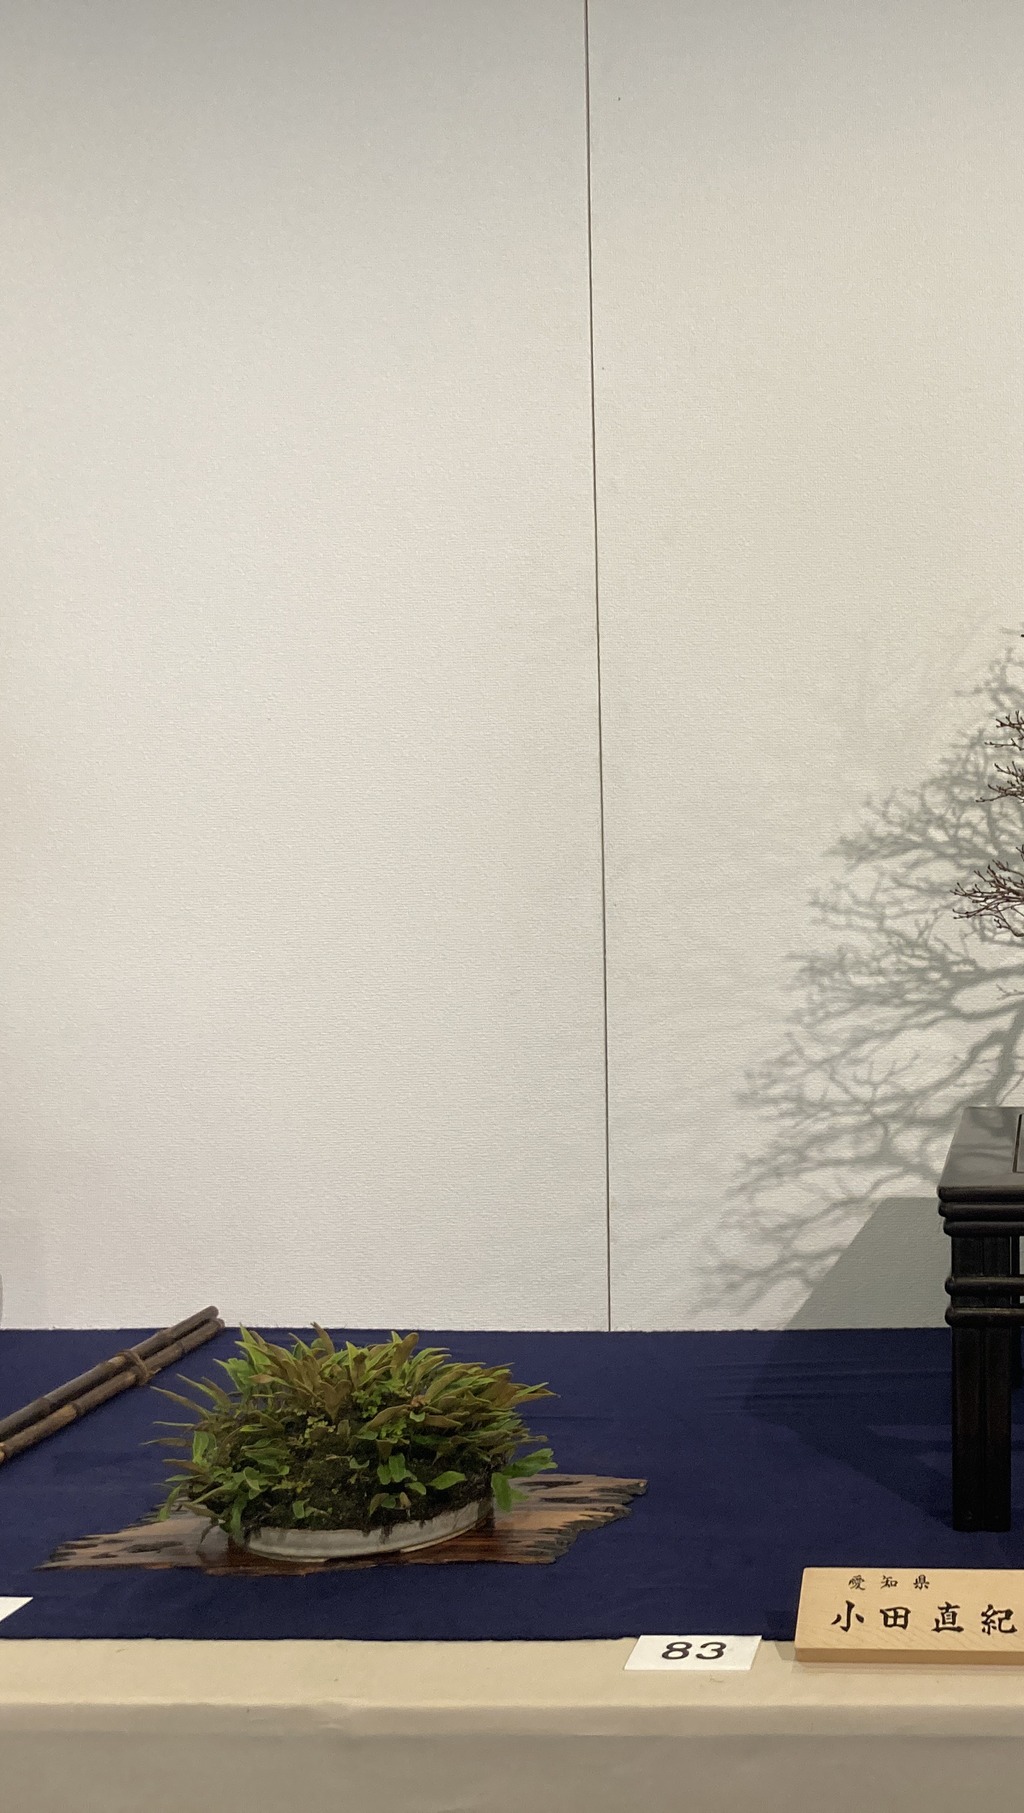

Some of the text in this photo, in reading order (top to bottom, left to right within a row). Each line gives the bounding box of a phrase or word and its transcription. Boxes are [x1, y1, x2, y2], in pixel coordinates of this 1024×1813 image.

[848, 1574, 930, 1591] 愛知県
[830, 1600, 1018, 1636] 小田直紀
[661, 1641, 727, 1660] 83
